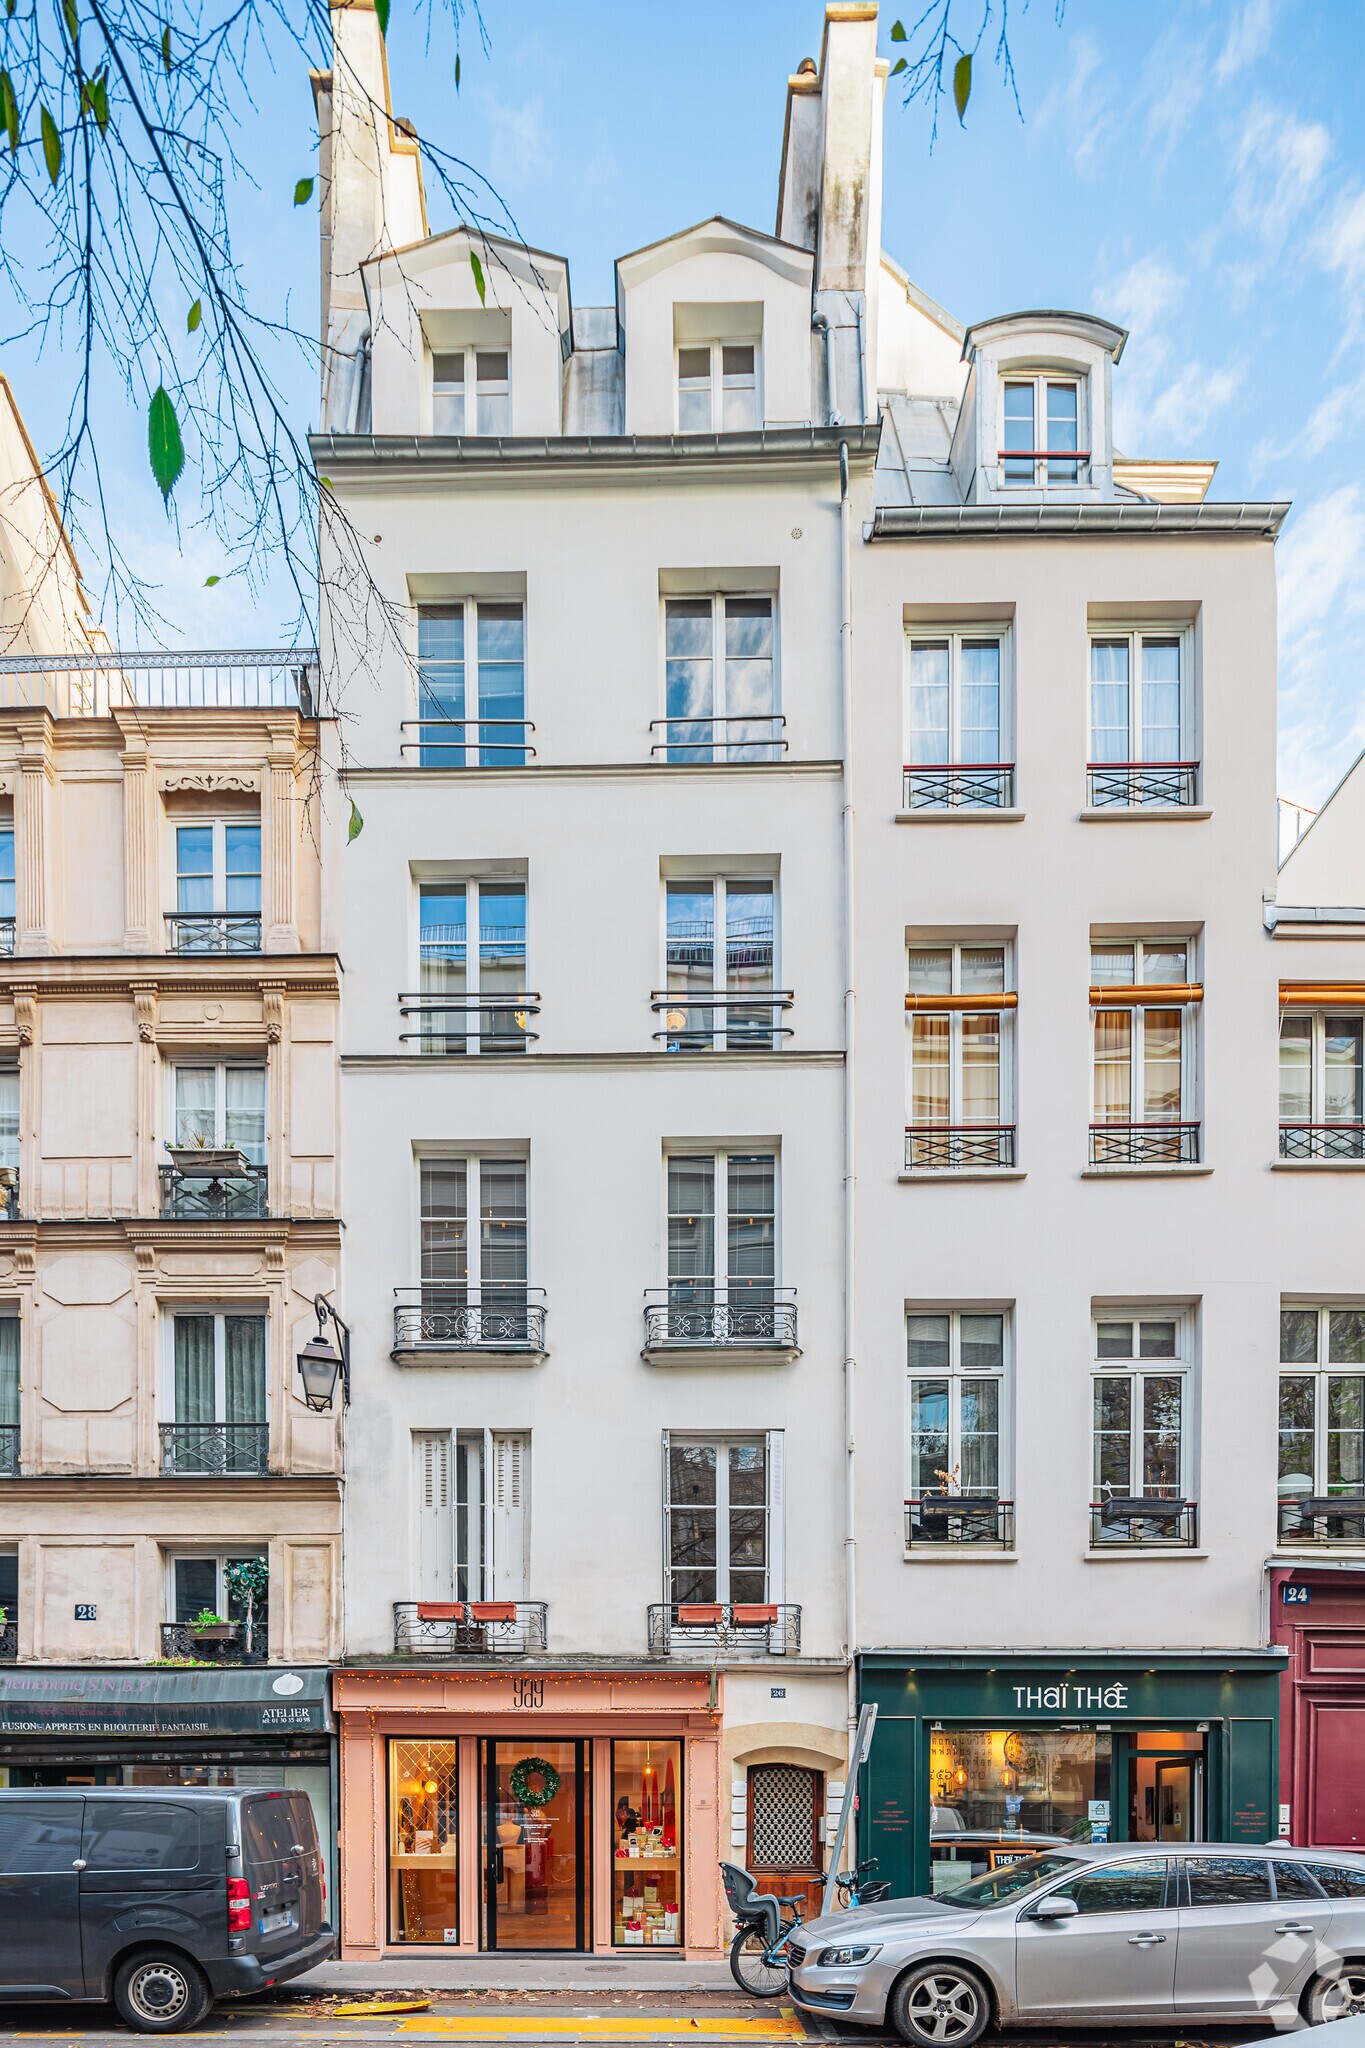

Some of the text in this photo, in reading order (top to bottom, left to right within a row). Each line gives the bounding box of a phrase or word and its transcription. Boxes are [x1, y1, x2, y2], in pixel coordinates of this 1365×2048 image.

[1288, 1587, 1307, 1602] 24
[77, 1605, 97, 1619] 28
[262, 1708, 309, 1718] ATELIER
[45, 1723, 86, 1731] APPRETS
[88, 1723, 101, 1731] EN
[103, 1723, 160, 1732] BIJOUTERIE
[161, 1722, 209, 1732] FANTAISIE
